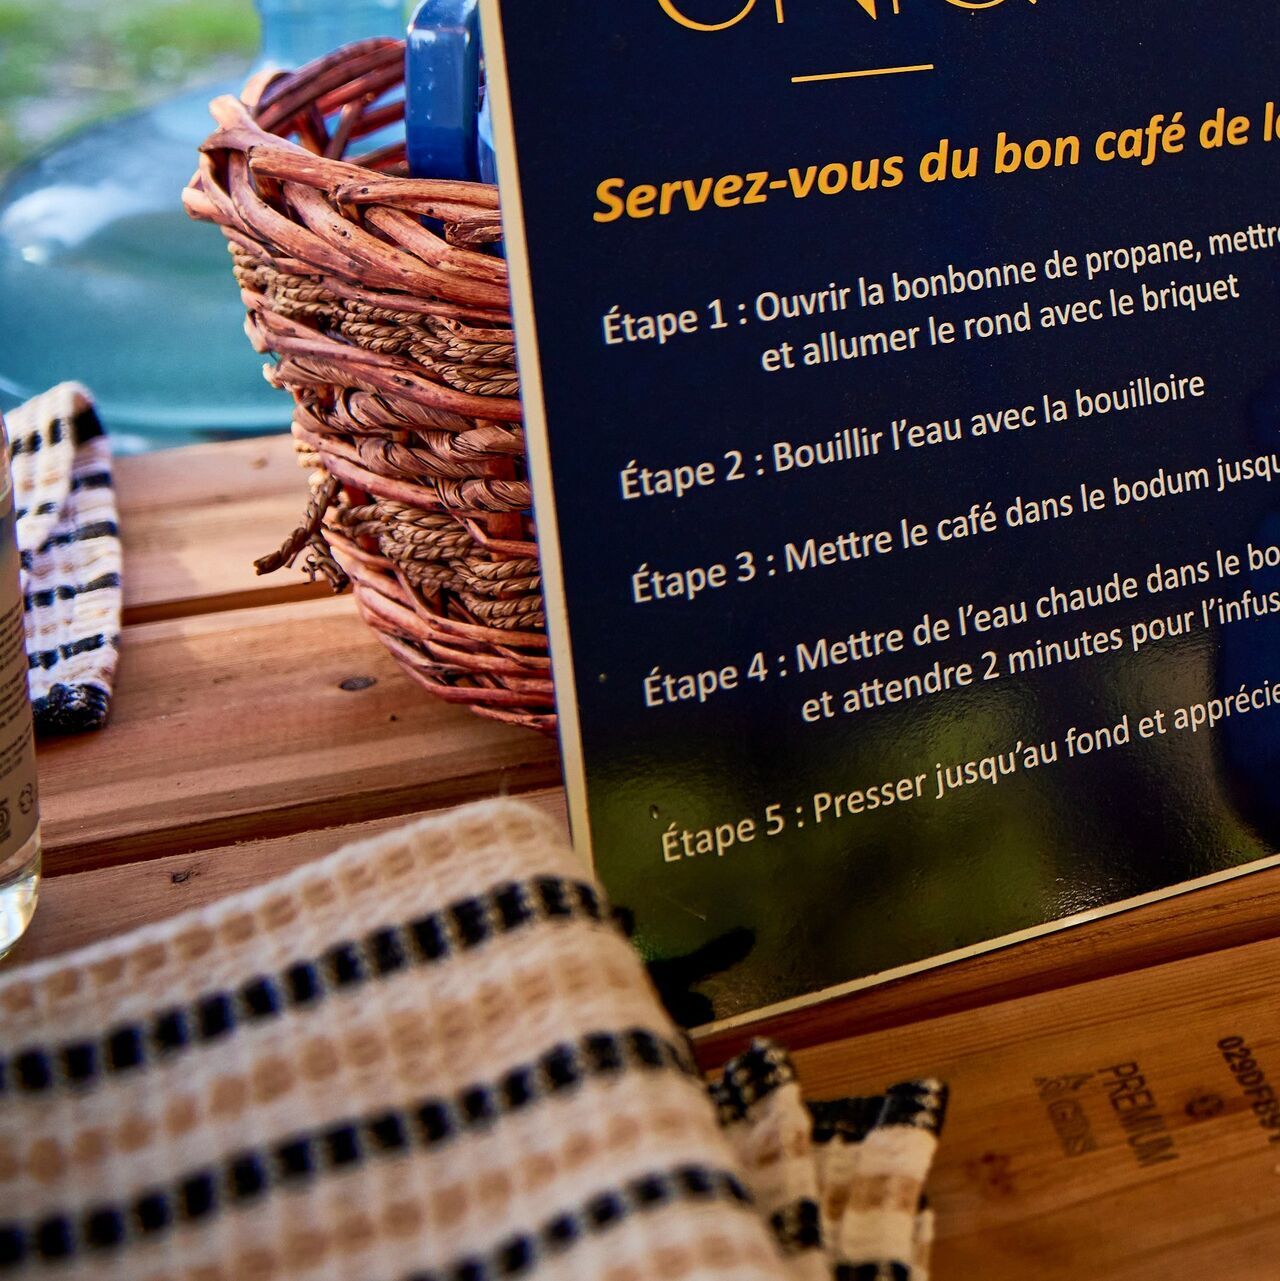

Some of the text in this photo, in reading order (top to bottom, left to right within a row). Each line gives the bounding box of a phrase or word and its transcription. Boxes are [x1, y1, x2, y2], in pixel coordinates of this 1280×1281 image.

[593, 156, 904, 222] Servez-vous
[919, 139, 978, 182] du
[995, 132, 1080, 174] bon
[1095, 112, 1185, 166] café
[1199, 107, 1250, 149] de
[603, 305, 698, 344] Étape
[708, 299, 728, 329] 1
[756, 283, 851, 321] Ouvrir
[859, 277, 884, 306] la
[892, 262, 1036, 301] bonbonne
[1045, 250, 1077, 279] de
[1086, 239, 1201, 280] propane,
[762, 274, 1240, 371] et allumer le rond avec le briquet
[621, 460, 715, 499] Étape
[724, 450, 745, 480] 2
[773, 428, 883, 472] Bouillir
[971, 406, 1036, 436] avec
[1043, 395, 1068, 423] la
[1076, 374, 1204, 417] bouilloire
[632, 563, 726, 603] Étape
[736, 551, 756, 581] 3
[785, 531, 892, 572] Mettre
[901, 519, 928, 548] le
[938, 502, 997, 540] café
[1006, 495, 1073, 527] dans
[1081, 484, 1105, 512] le
[1113, 468, 1209, 505] bodum
[644, 666, 738, 706] Étape
[748, 652, 768, 681] 4
[797, 630, 904, 672] Mettre
[913, 614, 950, 646] de
[1036, 573, 1138, 618] chaude
[1147, 562, 1209, 593] dans
[1217, 550, 1240, 577] le
[802, 691, 835, 721] et
[844, 662, 973, 712] attendre
[982, 651, 999, 680] 2
[1009, 629, 1123, 674] minutes
[1131, 611, 1194, 651] pour
[662, 819, 755, 862] Étape
[766, 804, 784, 835] 5
[814, 774, 926, 823] Presser
[1065, 715, 1129, 757] fond
[1139, 710, 1166, 738] et
